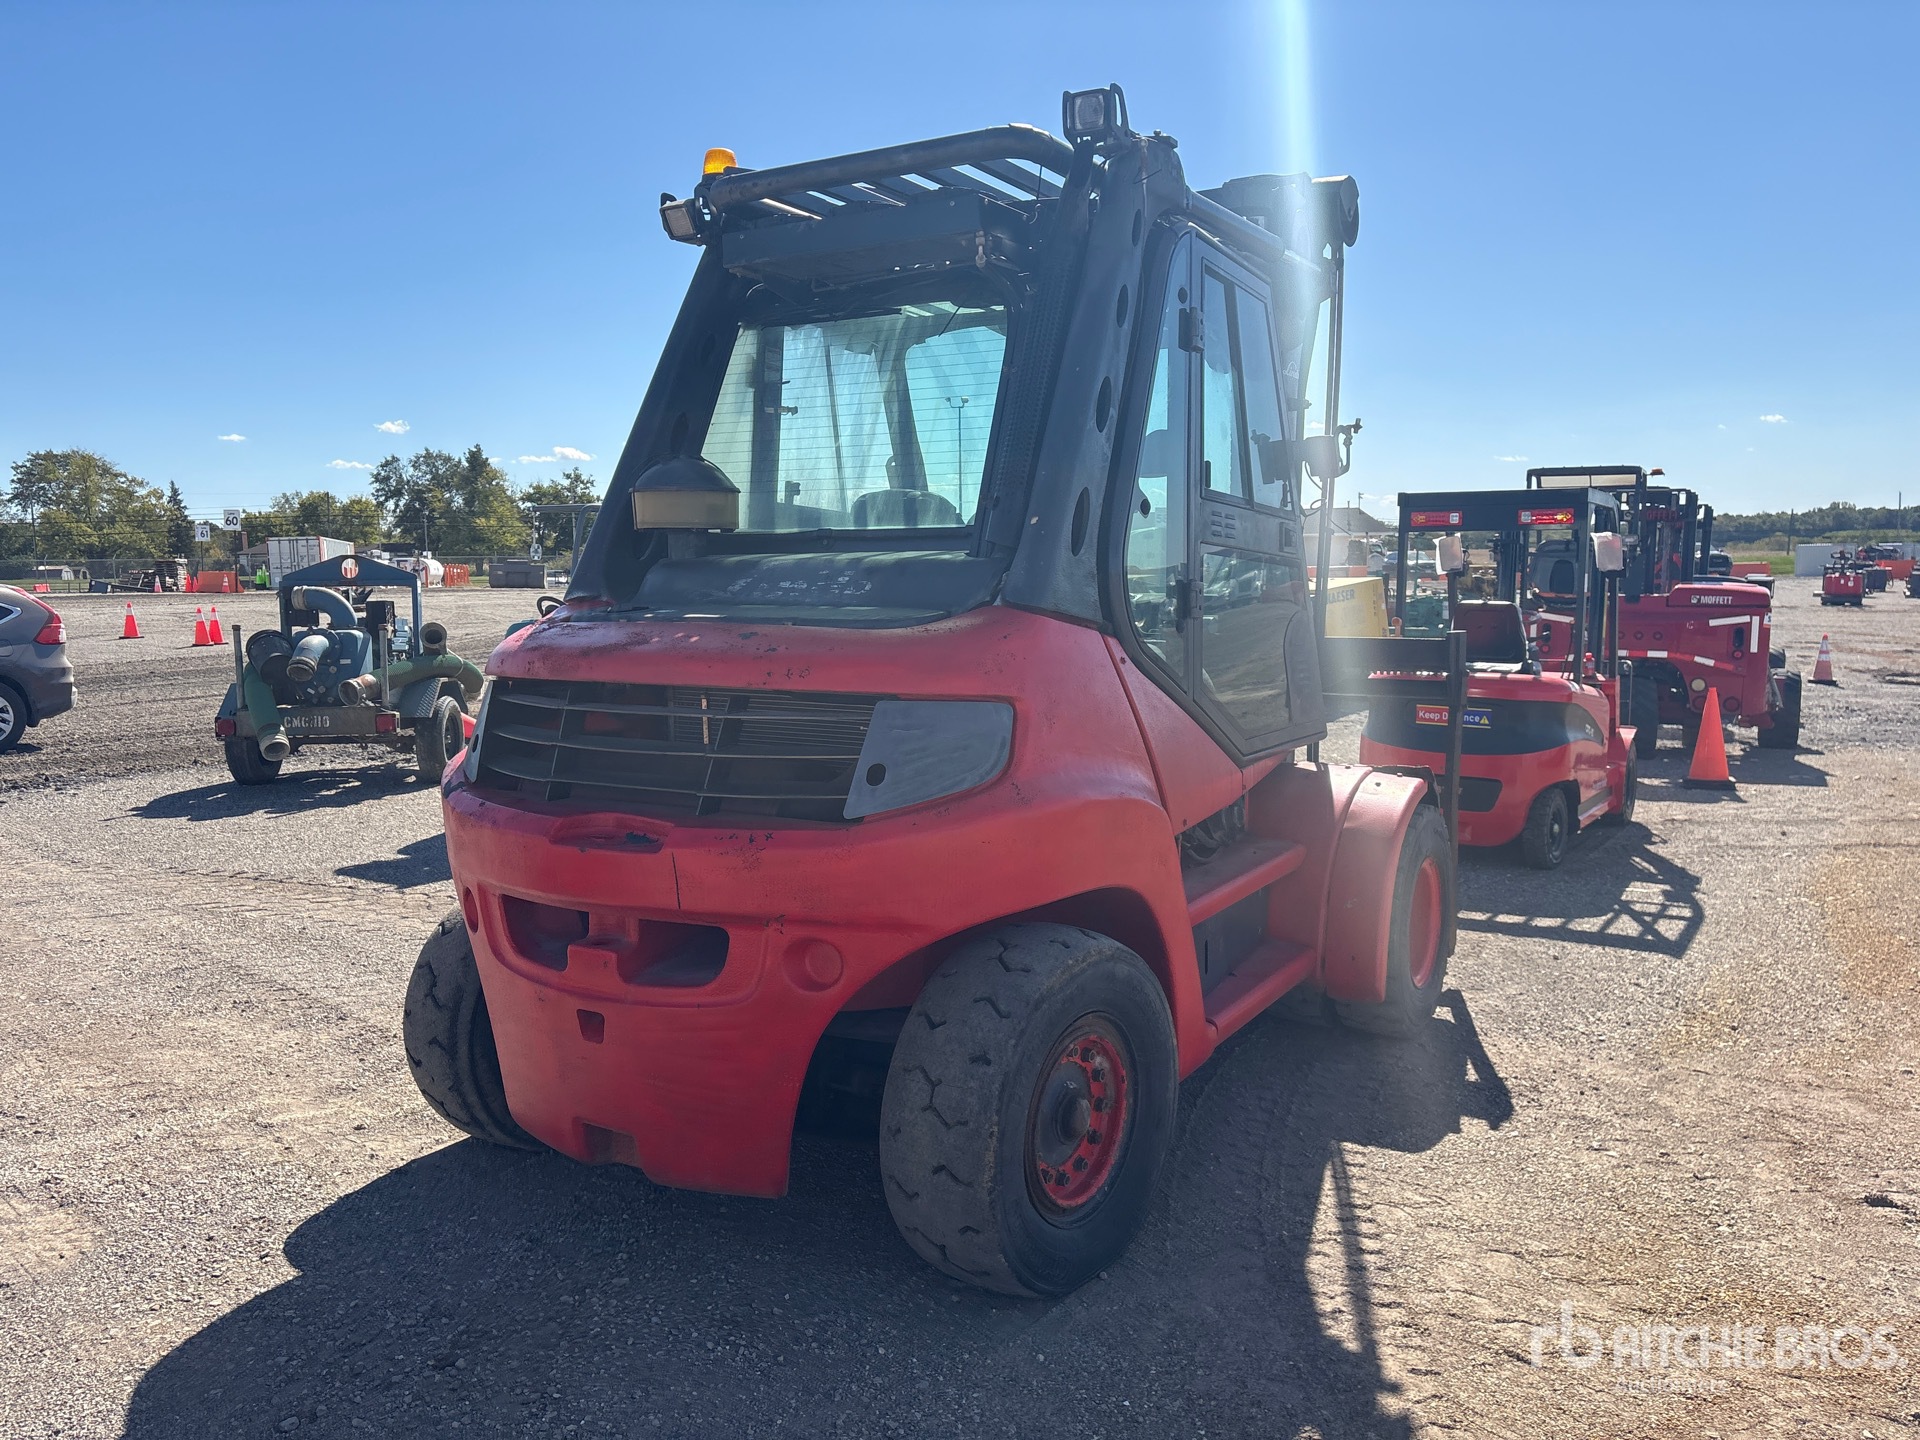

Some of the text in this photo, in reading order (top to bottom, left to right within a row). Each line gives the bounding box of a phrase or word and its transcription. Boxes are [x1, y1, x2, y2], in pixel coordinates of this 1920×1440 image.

[225, 516, 239, 526] 60
[200, 529, 209, 539] 61
[1700, 595, 1733, 605] MOFFETT
[1418, 710, 1441, 721] Keep
